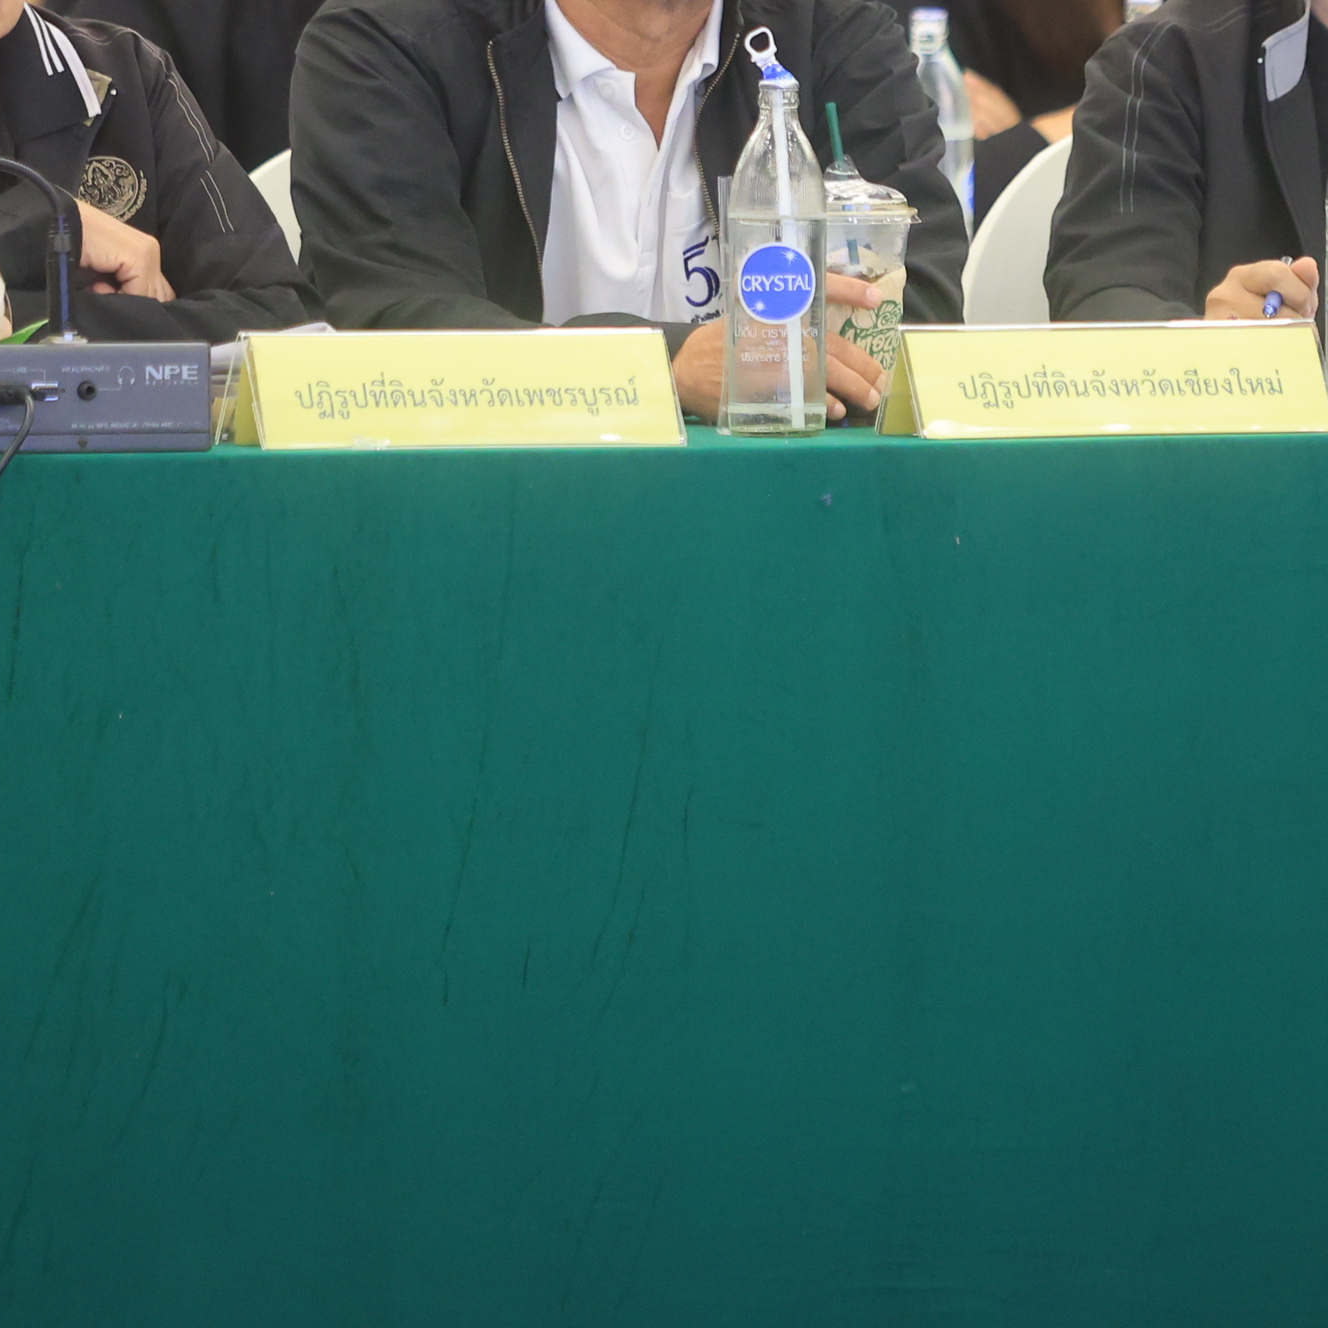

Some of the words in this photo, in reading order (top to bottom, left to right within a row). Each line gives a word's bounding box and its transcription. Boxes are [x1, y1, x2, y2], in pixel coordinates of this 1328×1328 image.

[742, 275, 811, 292] CRYSTAL
[145, 365, 199, 380] NPE
[958, 364, 1284, 410] ปฏิรูปที่ดินจังหวัดเชียงใหม่
[294, 372, 640, 420] ปฏิรูปที่ดินจังหวัดเพชรบูรณ์
